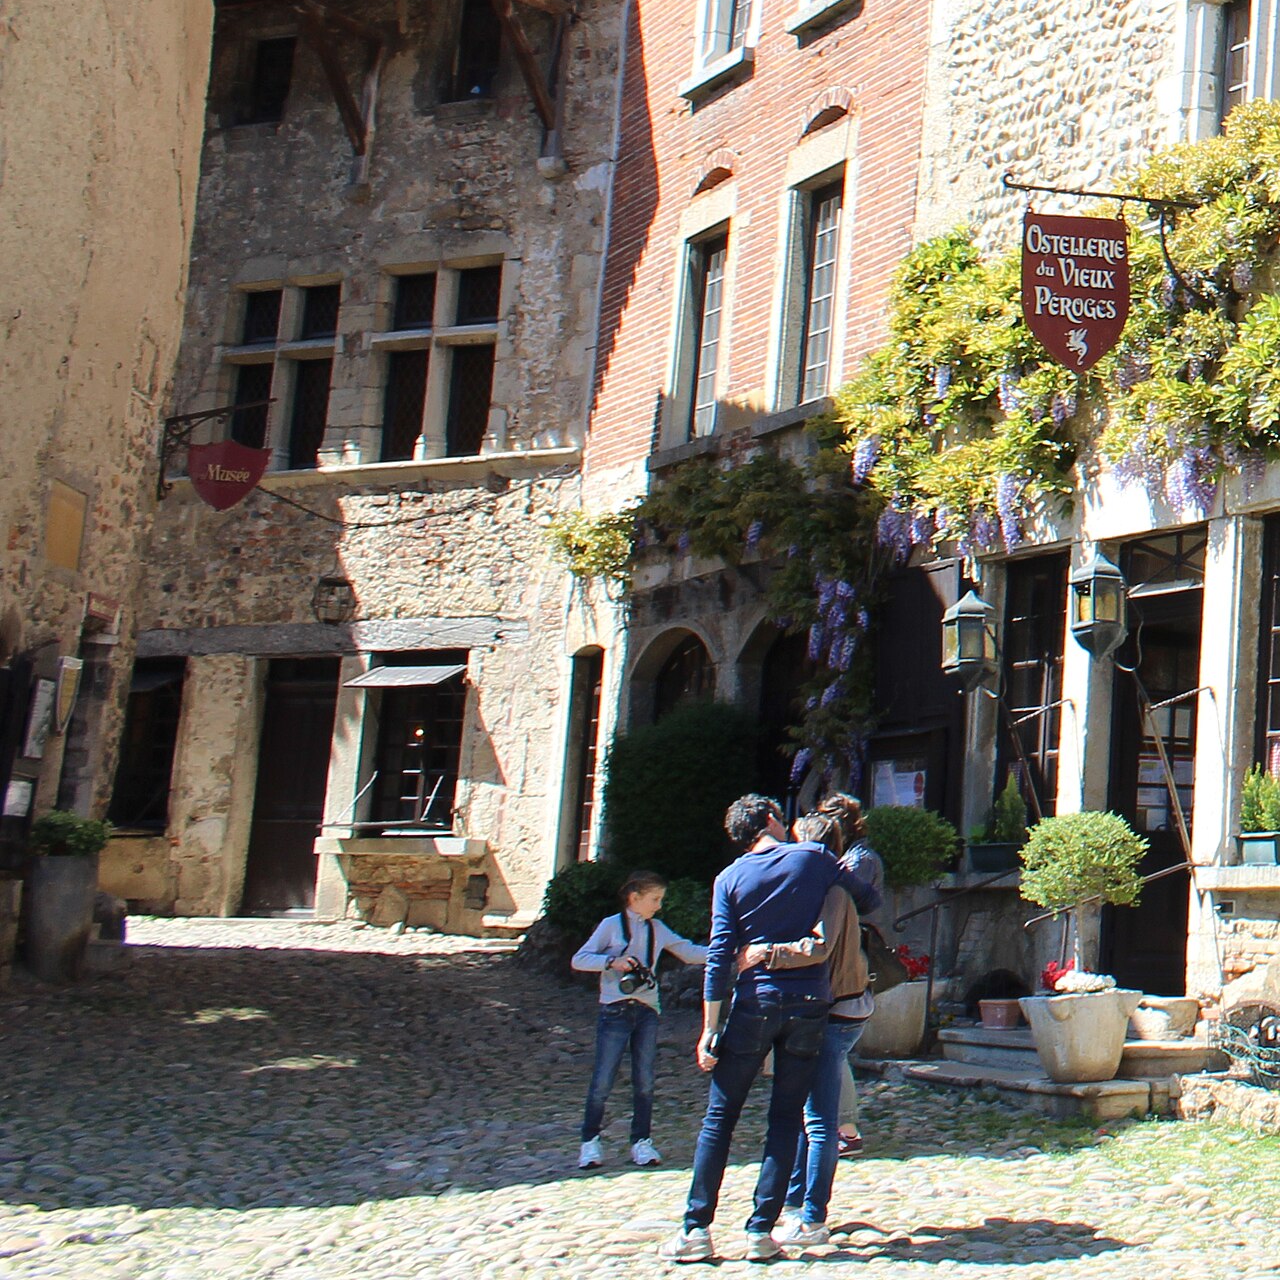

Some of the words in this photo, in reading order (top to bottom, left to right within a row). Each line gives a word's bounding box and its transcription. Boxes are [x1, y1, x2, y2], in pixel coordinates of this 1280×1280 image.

[1026, 224, 1126, 265] OSTELLERIE
[1036, 260, 1055, 277] du
[1058, 257, 1116, 290] VIEUX
[1034, 285, 1117, 324] PÉROGES
